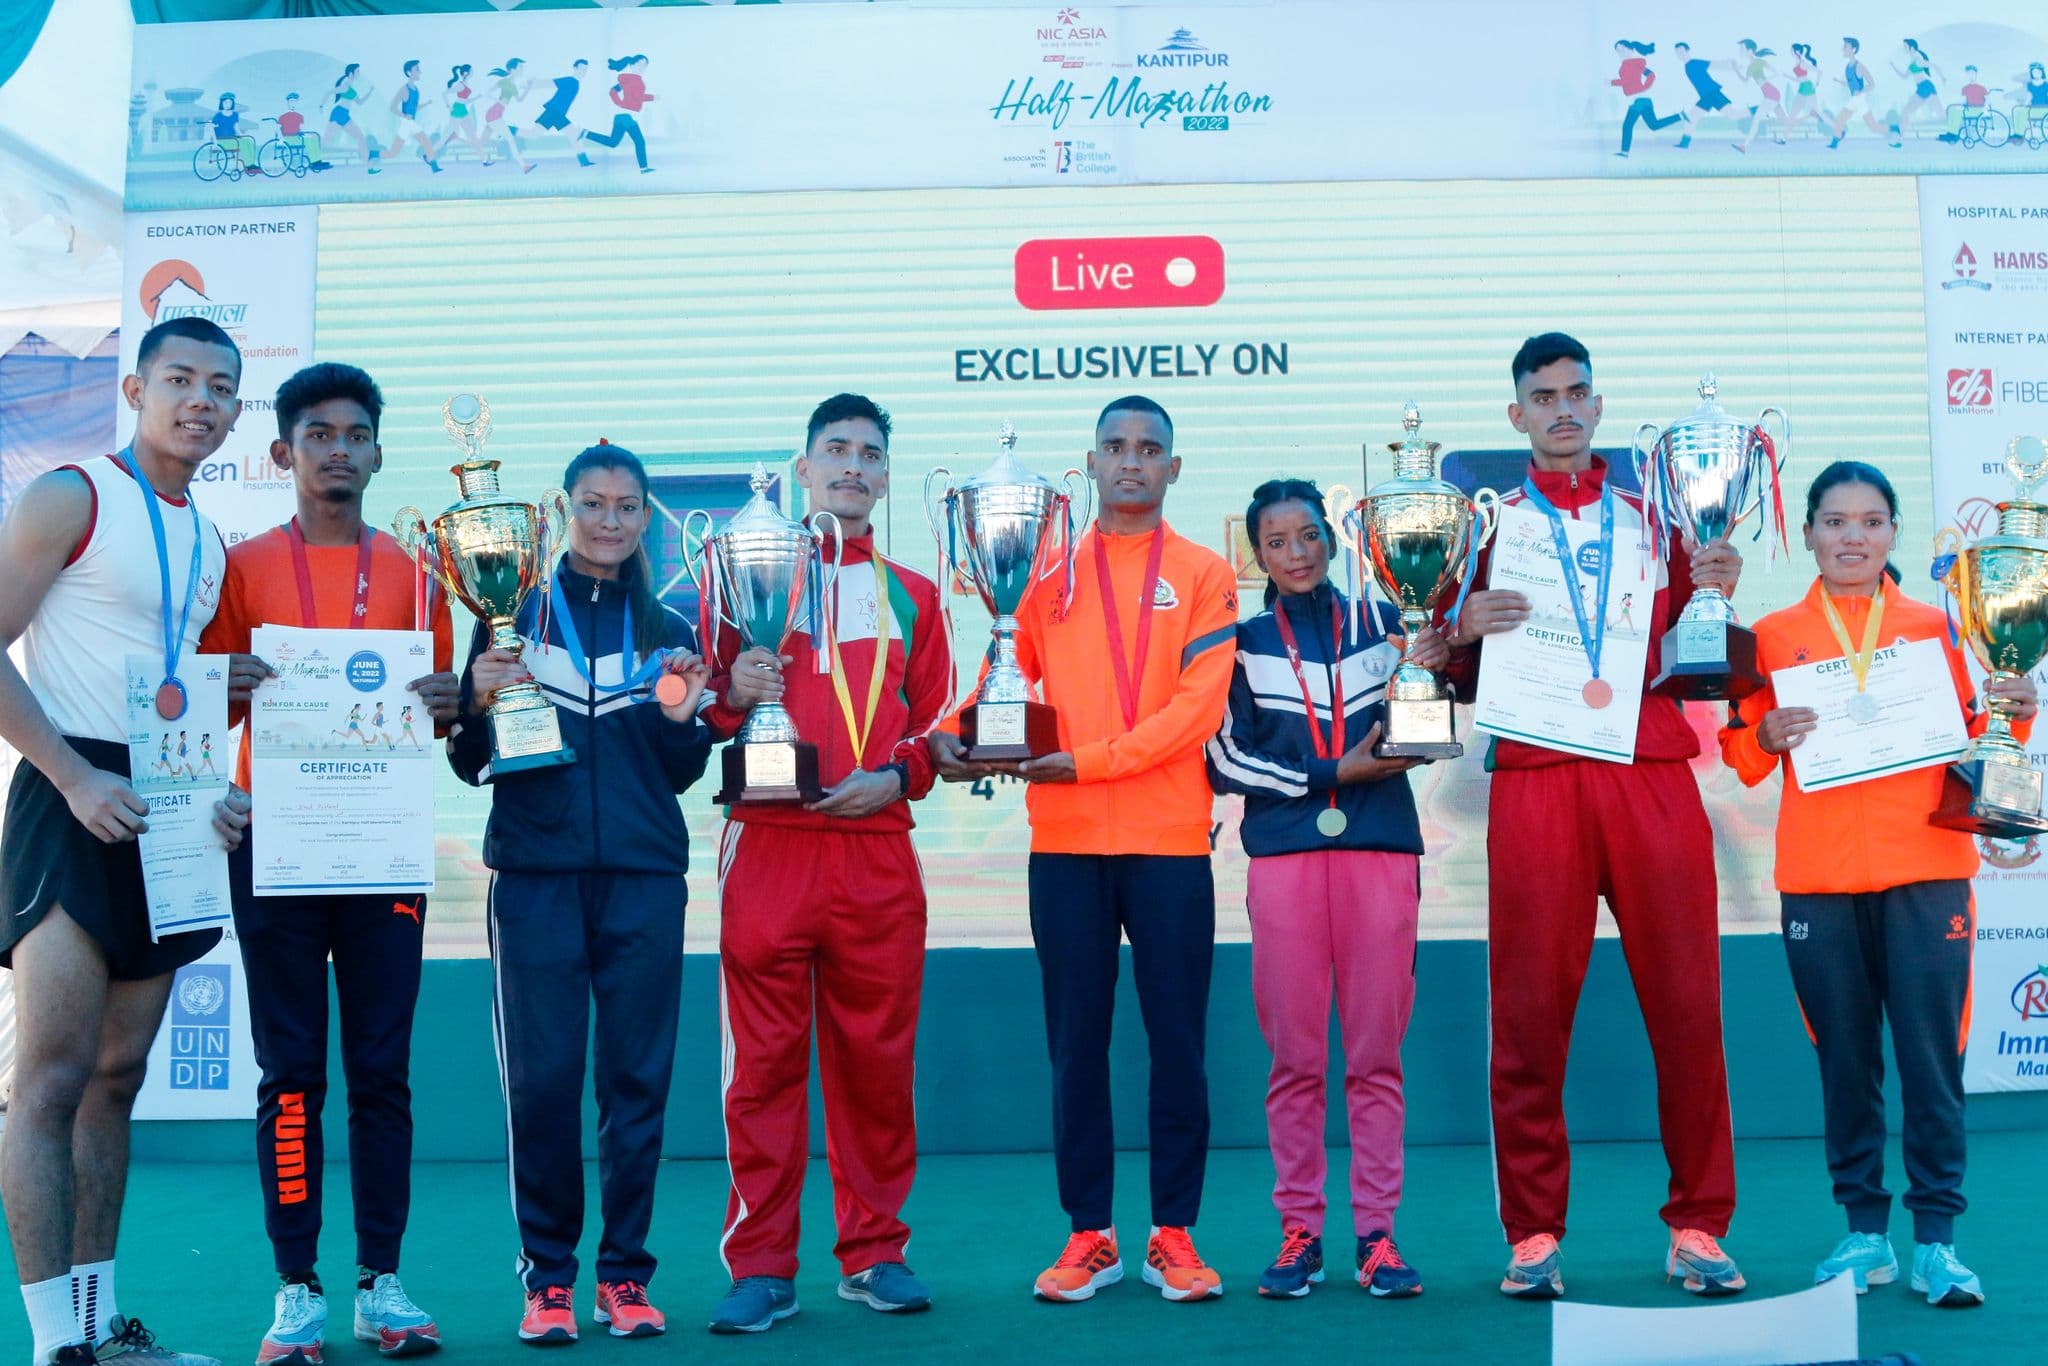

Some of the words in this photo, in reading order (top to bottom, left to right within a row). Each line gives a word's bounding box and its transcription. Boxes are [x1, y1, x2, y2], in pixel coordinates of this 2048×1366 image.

[1037, 28, 1063, 40] NIC
[1068, 27, 1107, 39] ASIA
[1137, 53, 1229, 67] KANTIPUR
[1186, 117, 1225, 130] 2022
[1076, 140, 1096, 149] The
[1076, 152, 1111, 161] British
[1076, 164, 1117, 174] College
[1947, 207, 2017, 218] HOSPITAL
[147, 225, 226, 237] EDUCATION
[231, 222, 296, 235] PARTNER
[1994, 252, 2048, 269] HAMS
[1051, 253, 1134, 291] Live
[1955, 333, 2023, 344] INTERNET
[2028, 333, 2048, 344] PA
[955, 344, 1220, 381] EXCLUSIVELY
[1233, 342, 1288, 375] ON
[1948, 407, 1994, 415] DishHome
[243, 482, 292, 490] Insurance
[230, 532, 248, 544] BY
[1526, 627, 1584, 646] CERTIFIC
[353, 661, 379, 669] JUNE
[300, 762, 388, 773] CERTIFICATE
[1977, 928, 2048, 940] BEVERAG
[275, 1092, 307, 1205] PUMA
